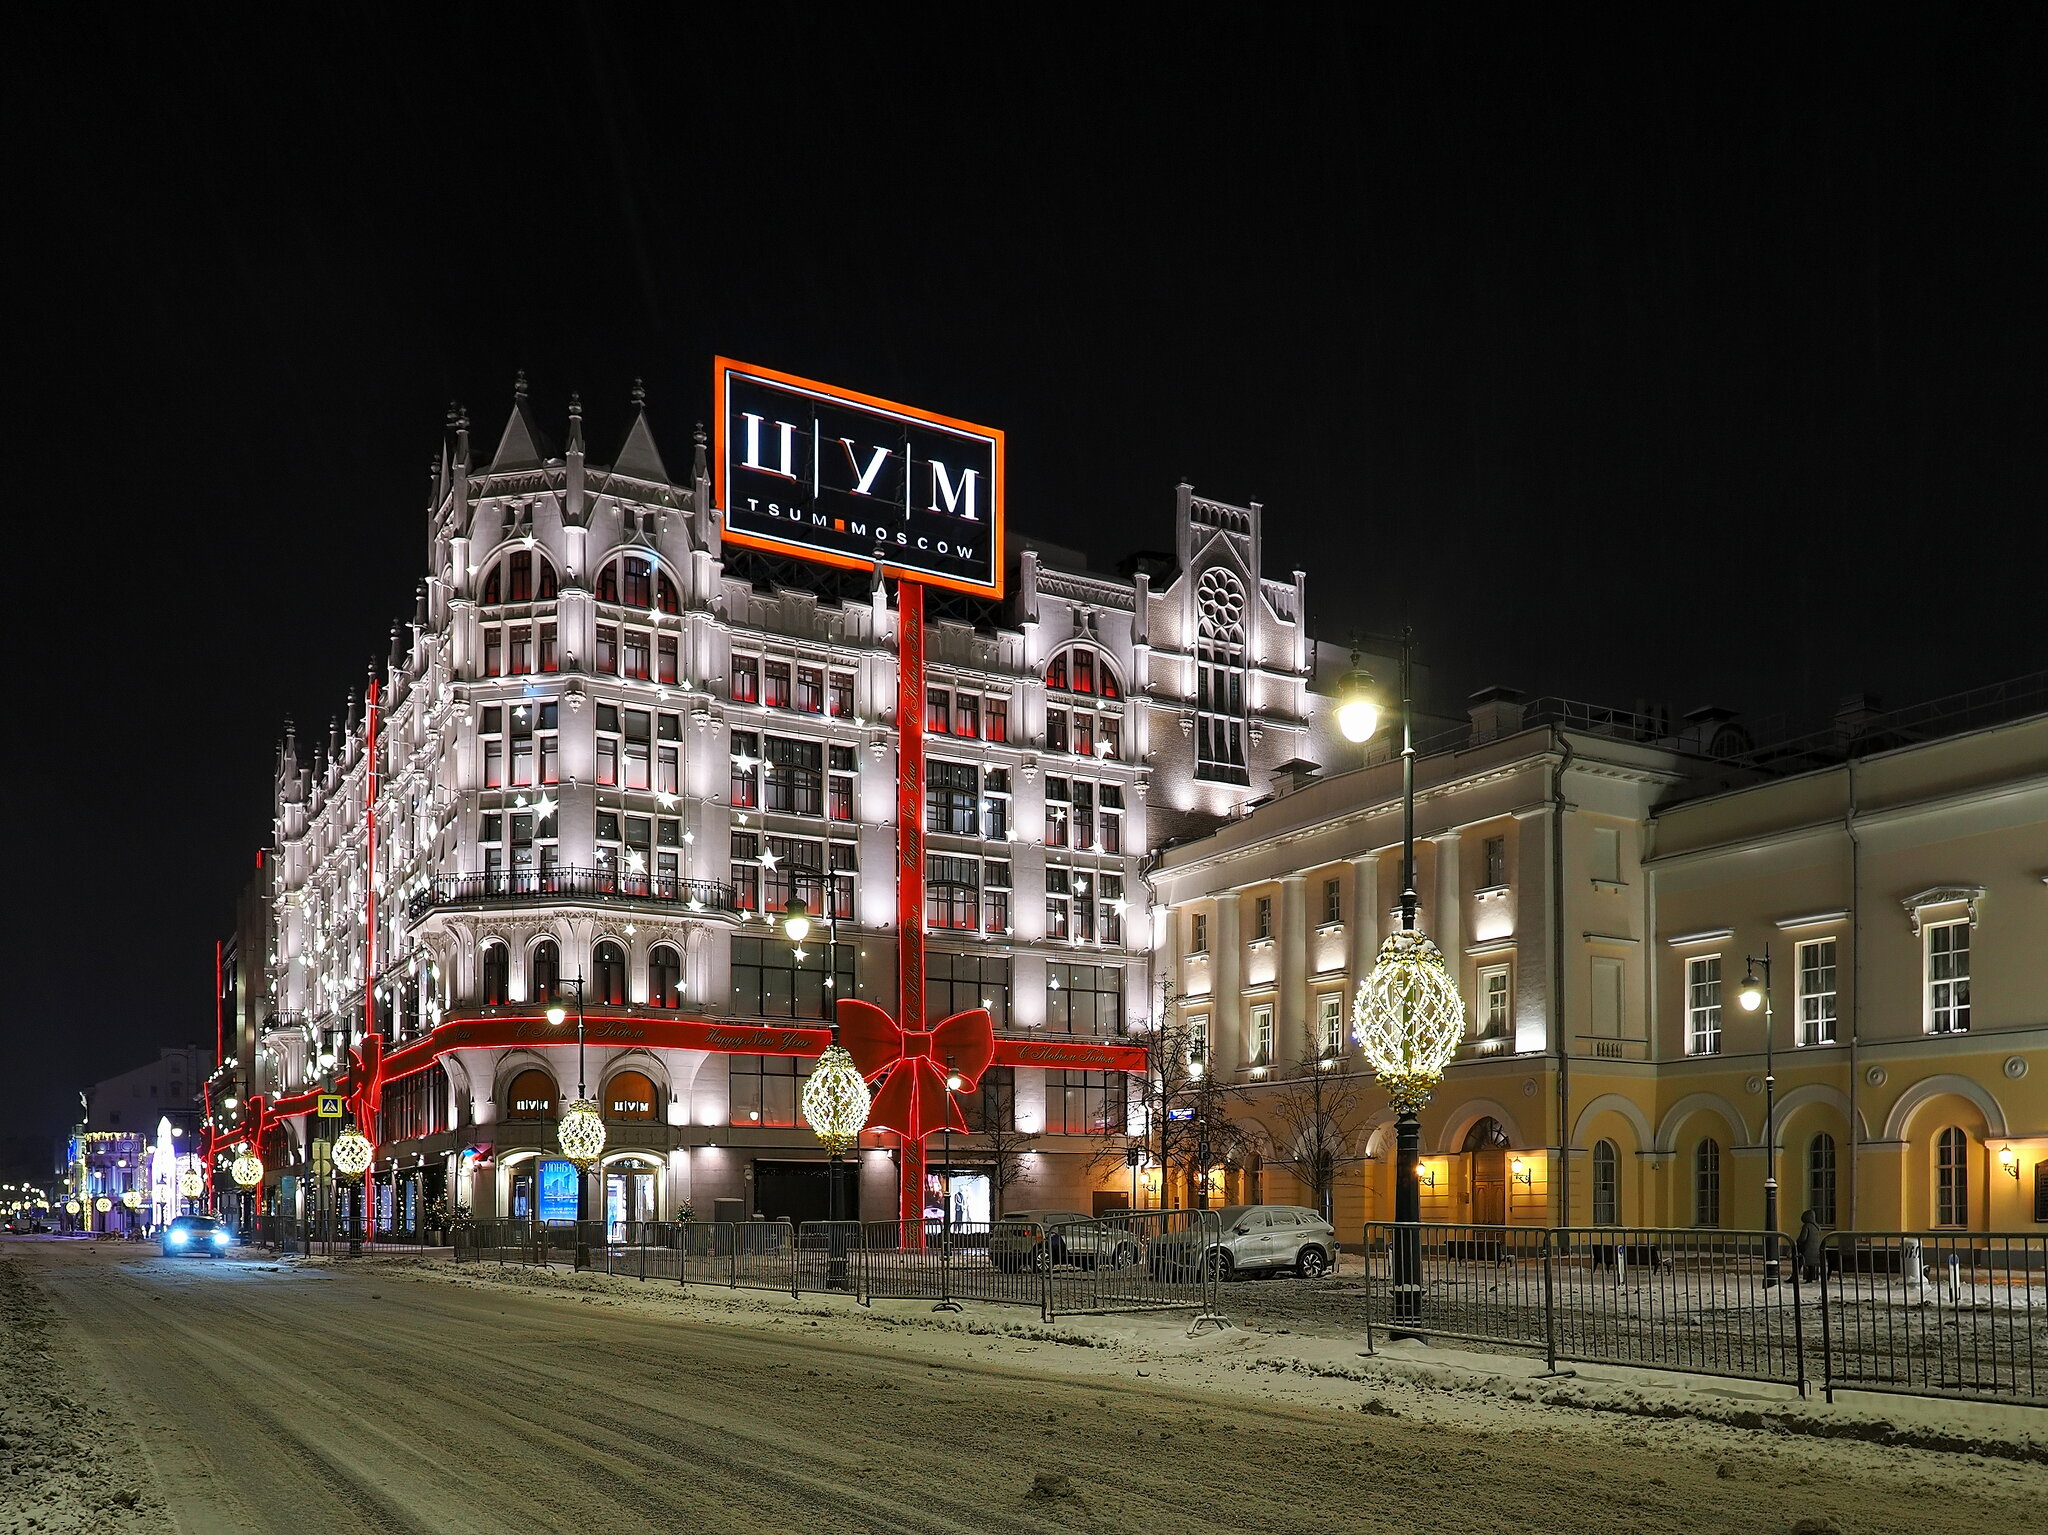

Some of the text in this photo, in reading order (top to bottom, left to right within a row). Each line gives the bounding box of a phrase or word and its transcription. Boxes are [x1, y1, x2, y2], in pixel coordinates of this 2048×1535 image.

[747, 498, 974, 560] TSUM MOSCOW
[902, 760, 920, 872] Happy New Year
[703, 1027, 813, 1051] Happy New Year
